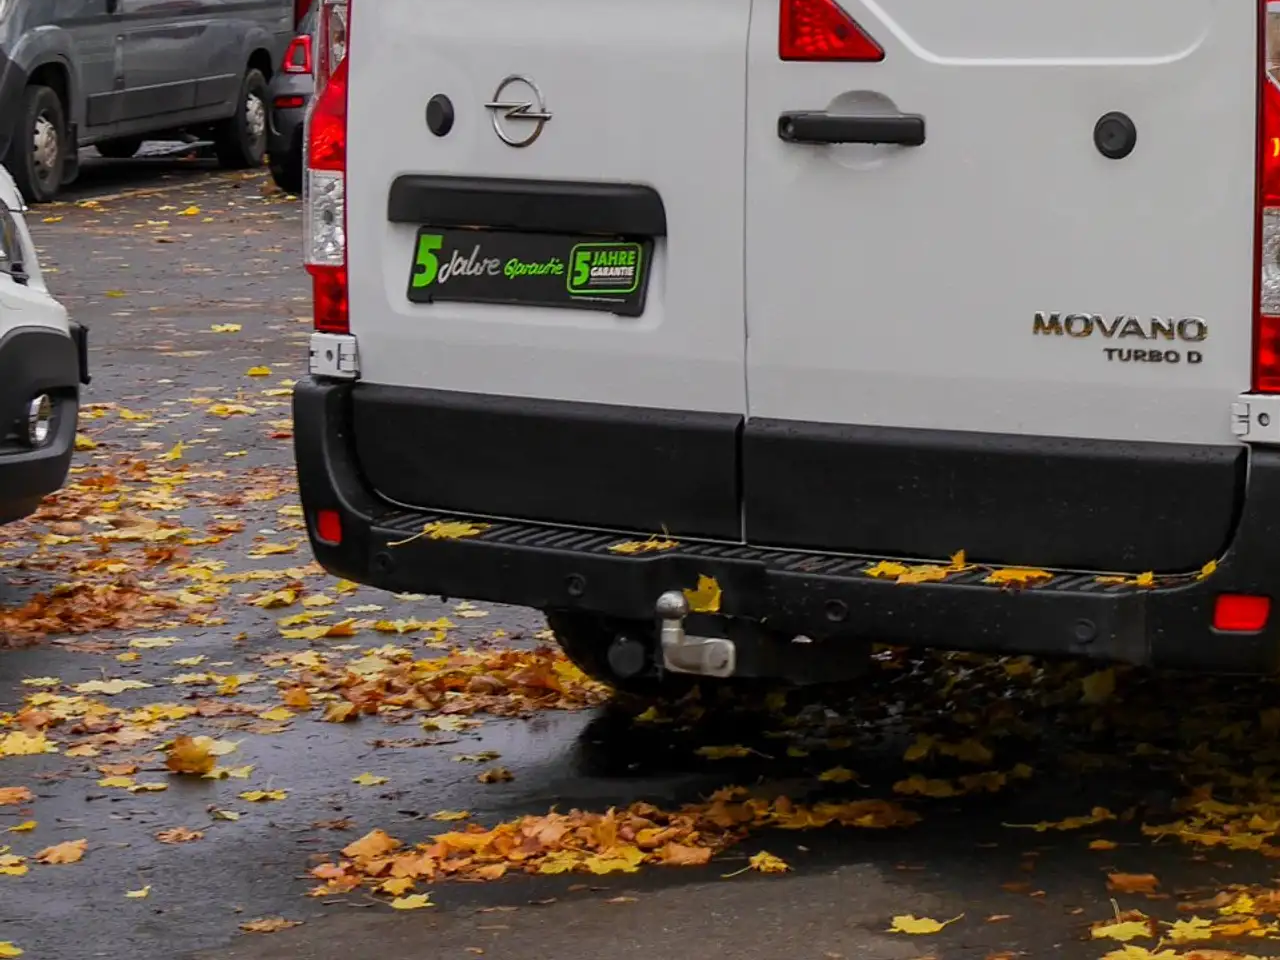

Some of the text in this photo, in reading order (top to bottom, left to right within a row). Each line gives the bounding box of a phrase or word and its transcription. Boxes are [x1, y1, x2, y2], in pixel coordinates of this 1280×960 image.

[412, 234, 564, 287] 5 Jahre Garantie
[573, 250, 635, 286] 5 JAHRE
[590, 266, 634, 276] GARANTIE
[1032, 311, 1208, 342] MOVANO
[1103, 348, 1203, 364] TURBO D
